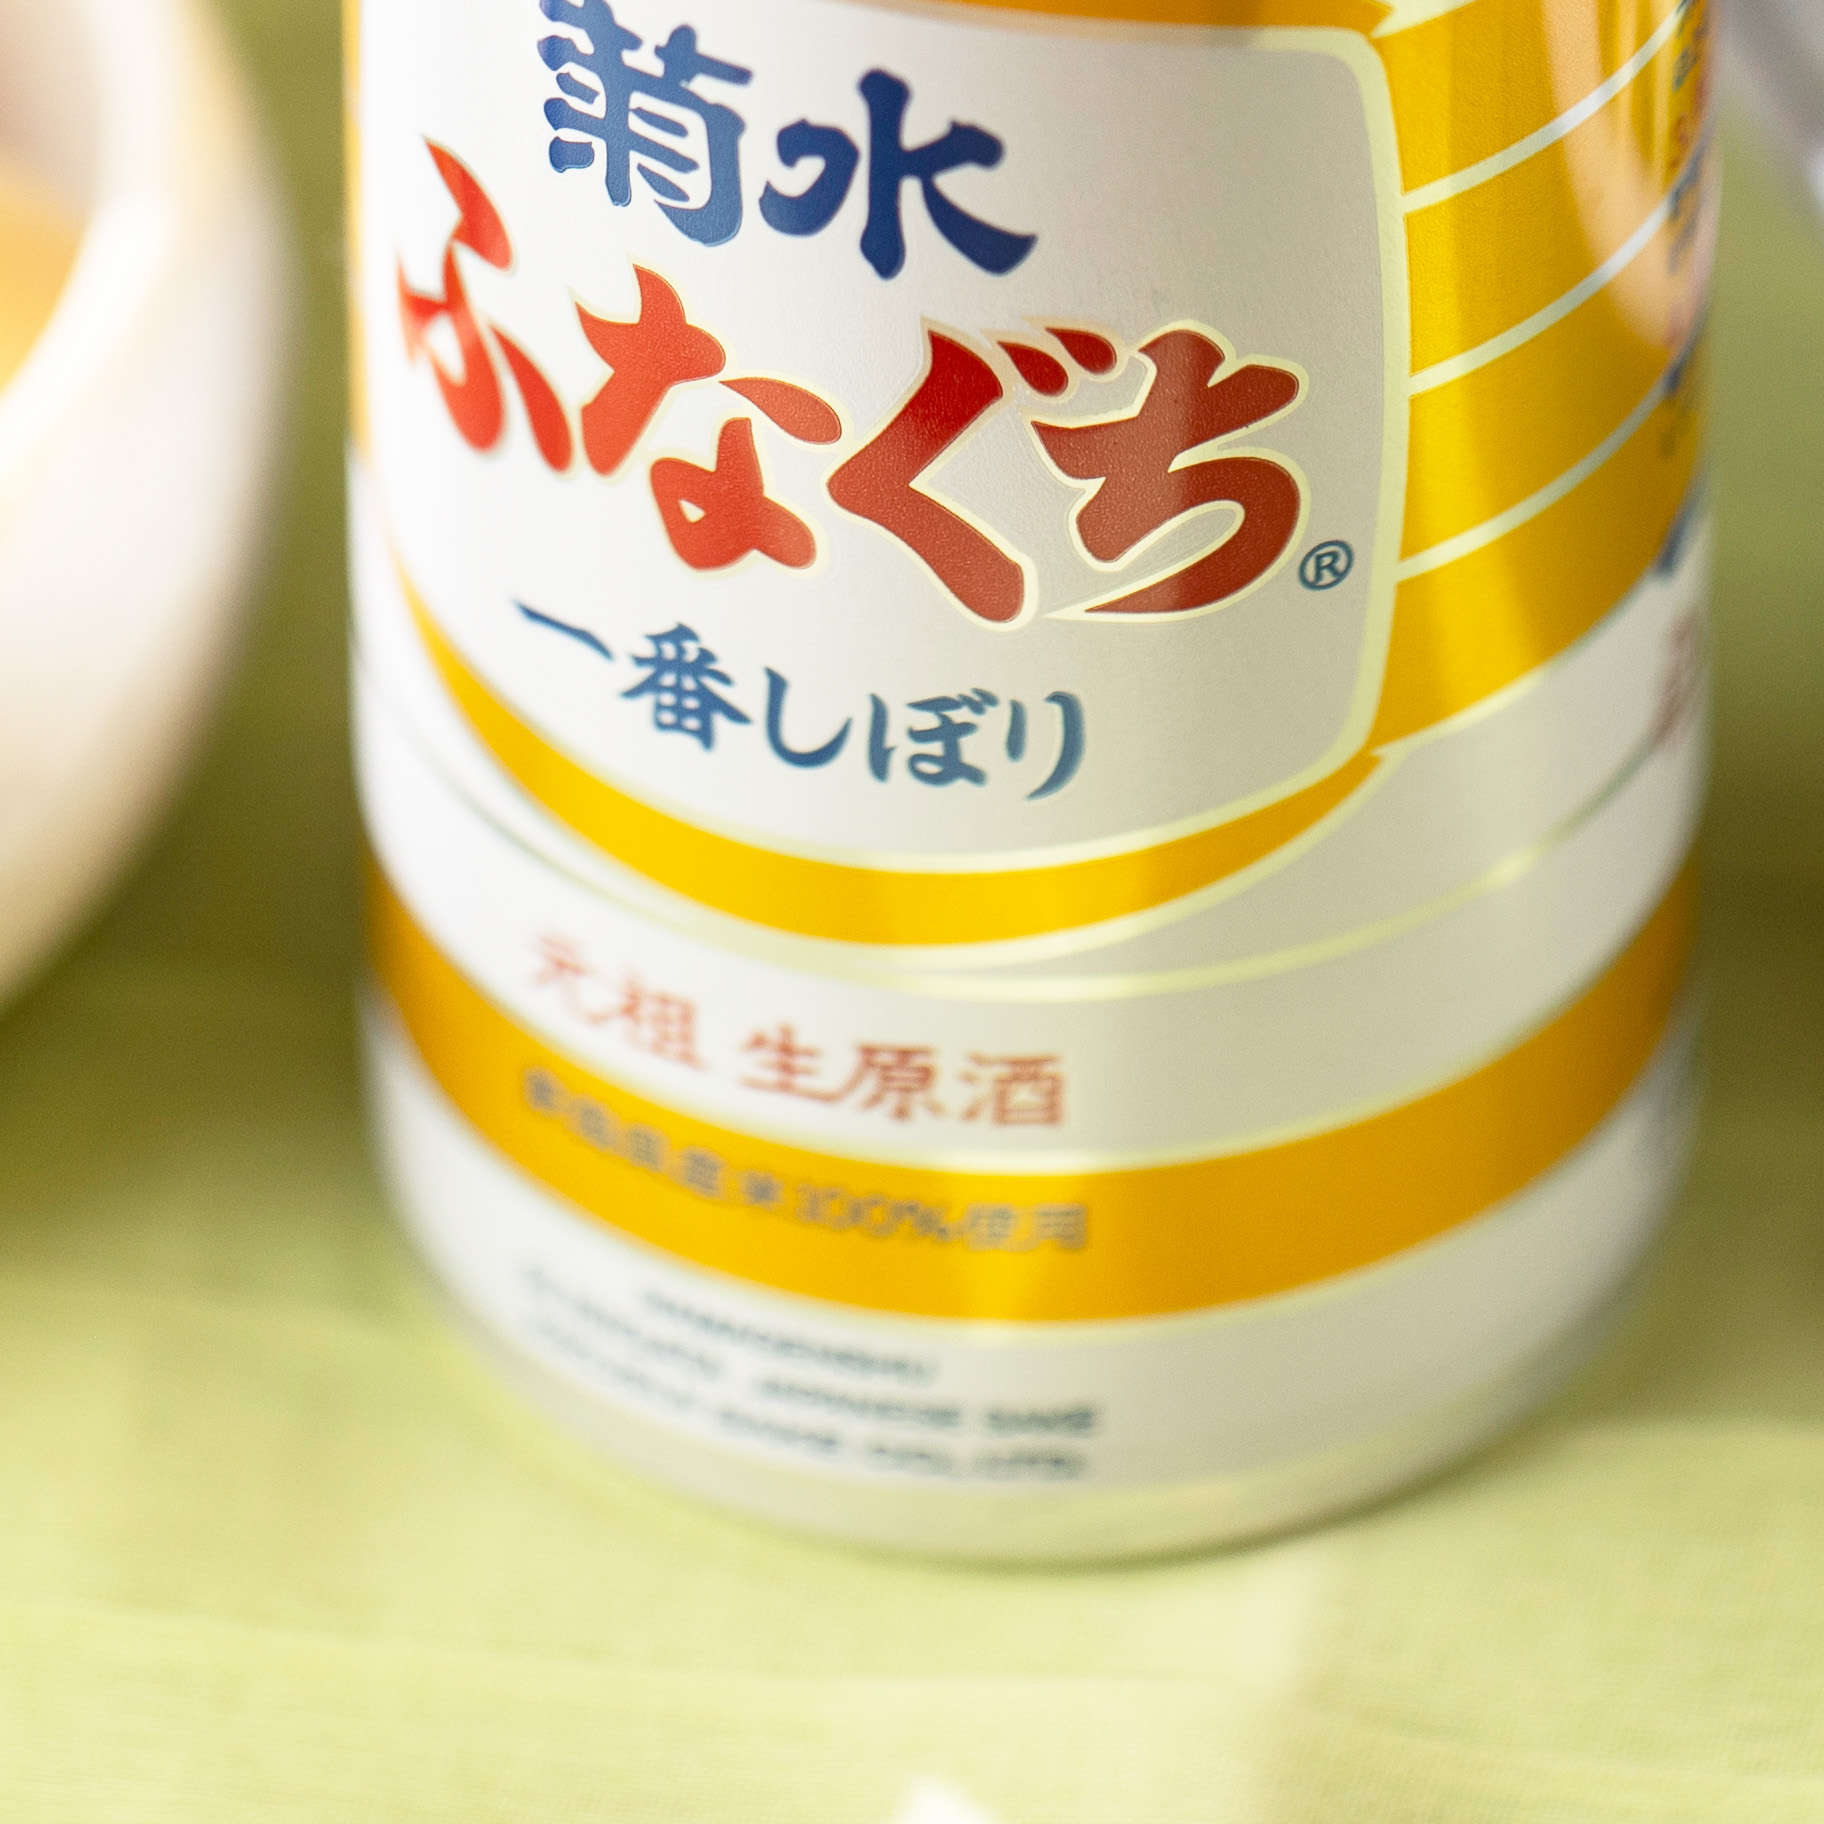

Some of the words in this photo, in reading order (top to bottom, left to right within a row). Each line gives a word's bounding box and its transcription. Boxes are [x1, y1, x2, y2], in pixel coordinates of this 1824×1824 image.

[396, 133, 1303, 625] ふなぐち
[514, 599, 1087, 800] 一番しぼり
[738, 1022, 1066, 1129] 生原酒
